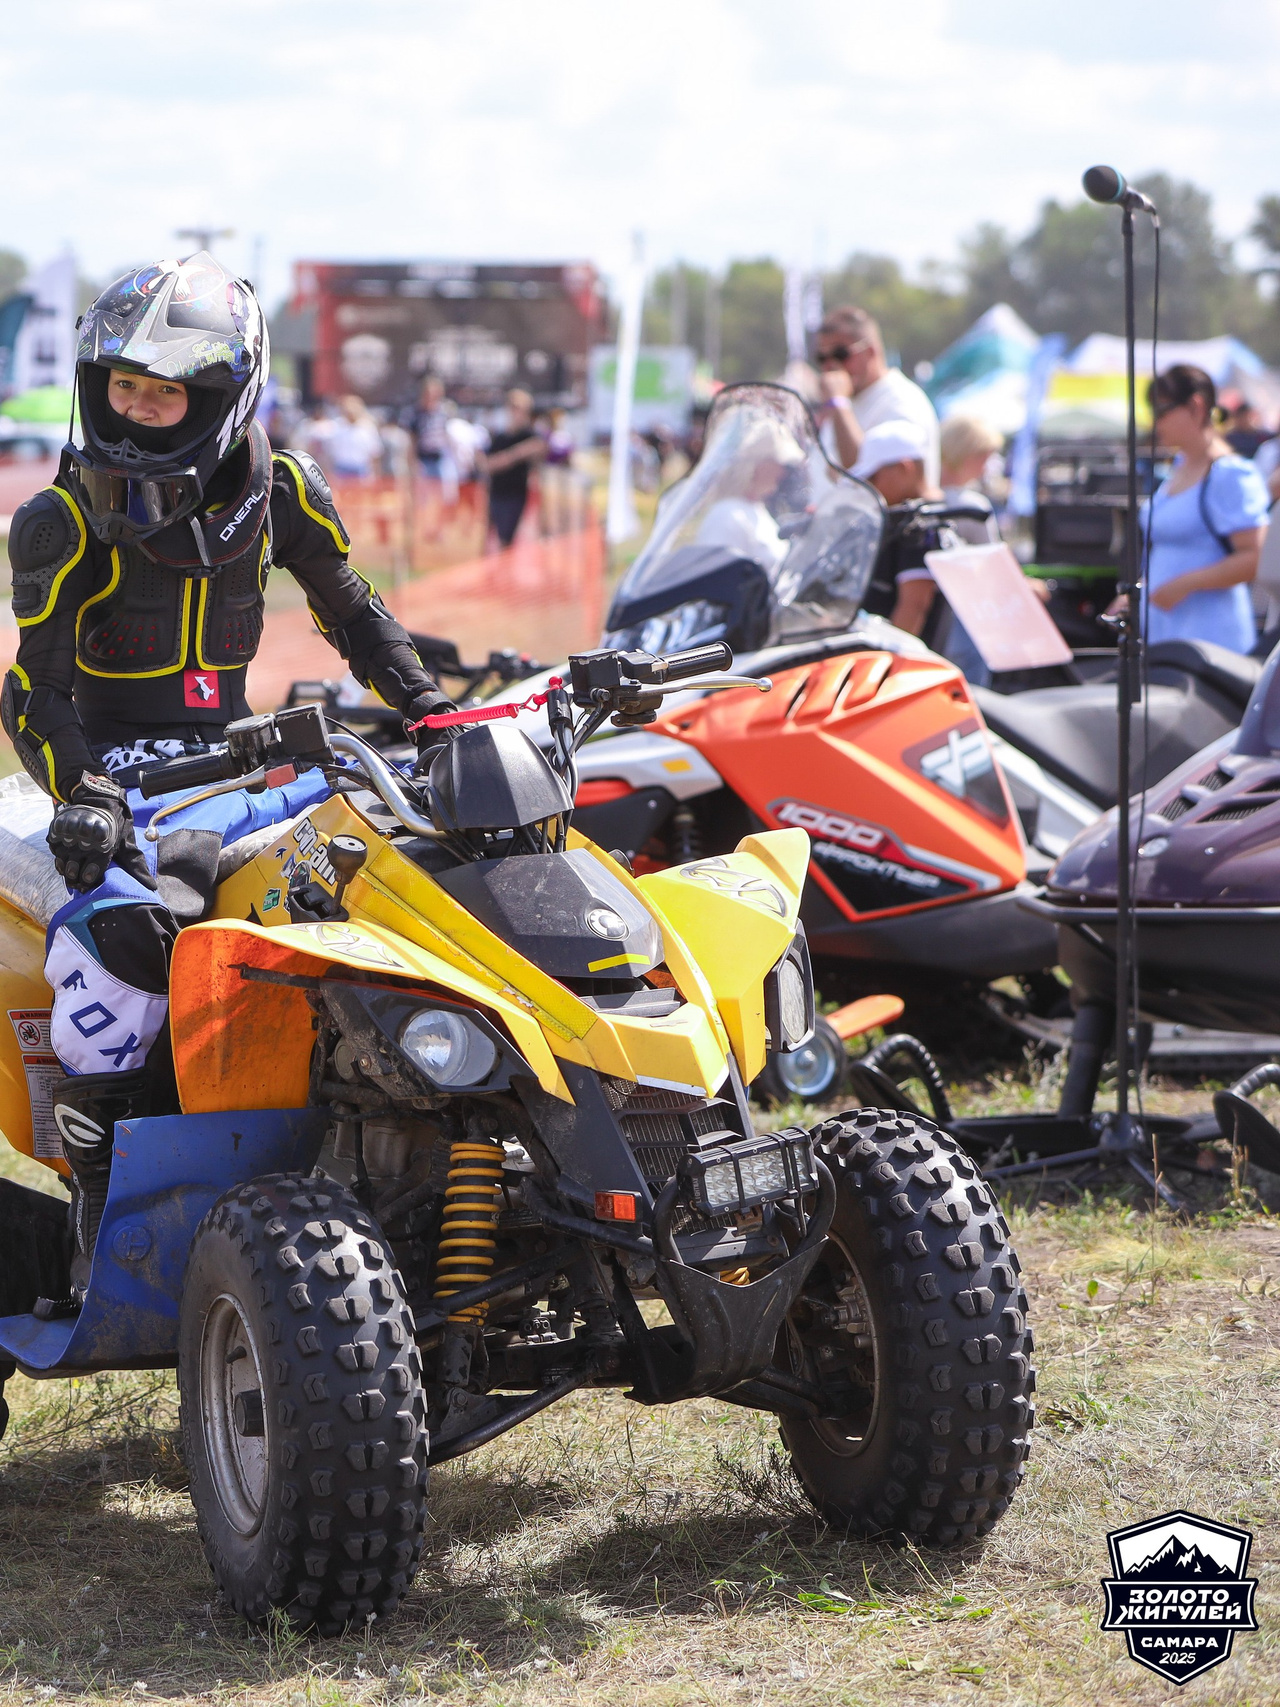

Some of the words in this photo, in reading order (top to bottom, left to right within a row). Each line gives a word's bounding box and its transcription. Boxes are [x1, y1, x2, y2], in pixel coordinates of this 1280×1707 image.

[219, 490, 265, 541] ONEAL
[777, 802, 885, 848] 1000
[61, 969, 142, 1068] FOX
